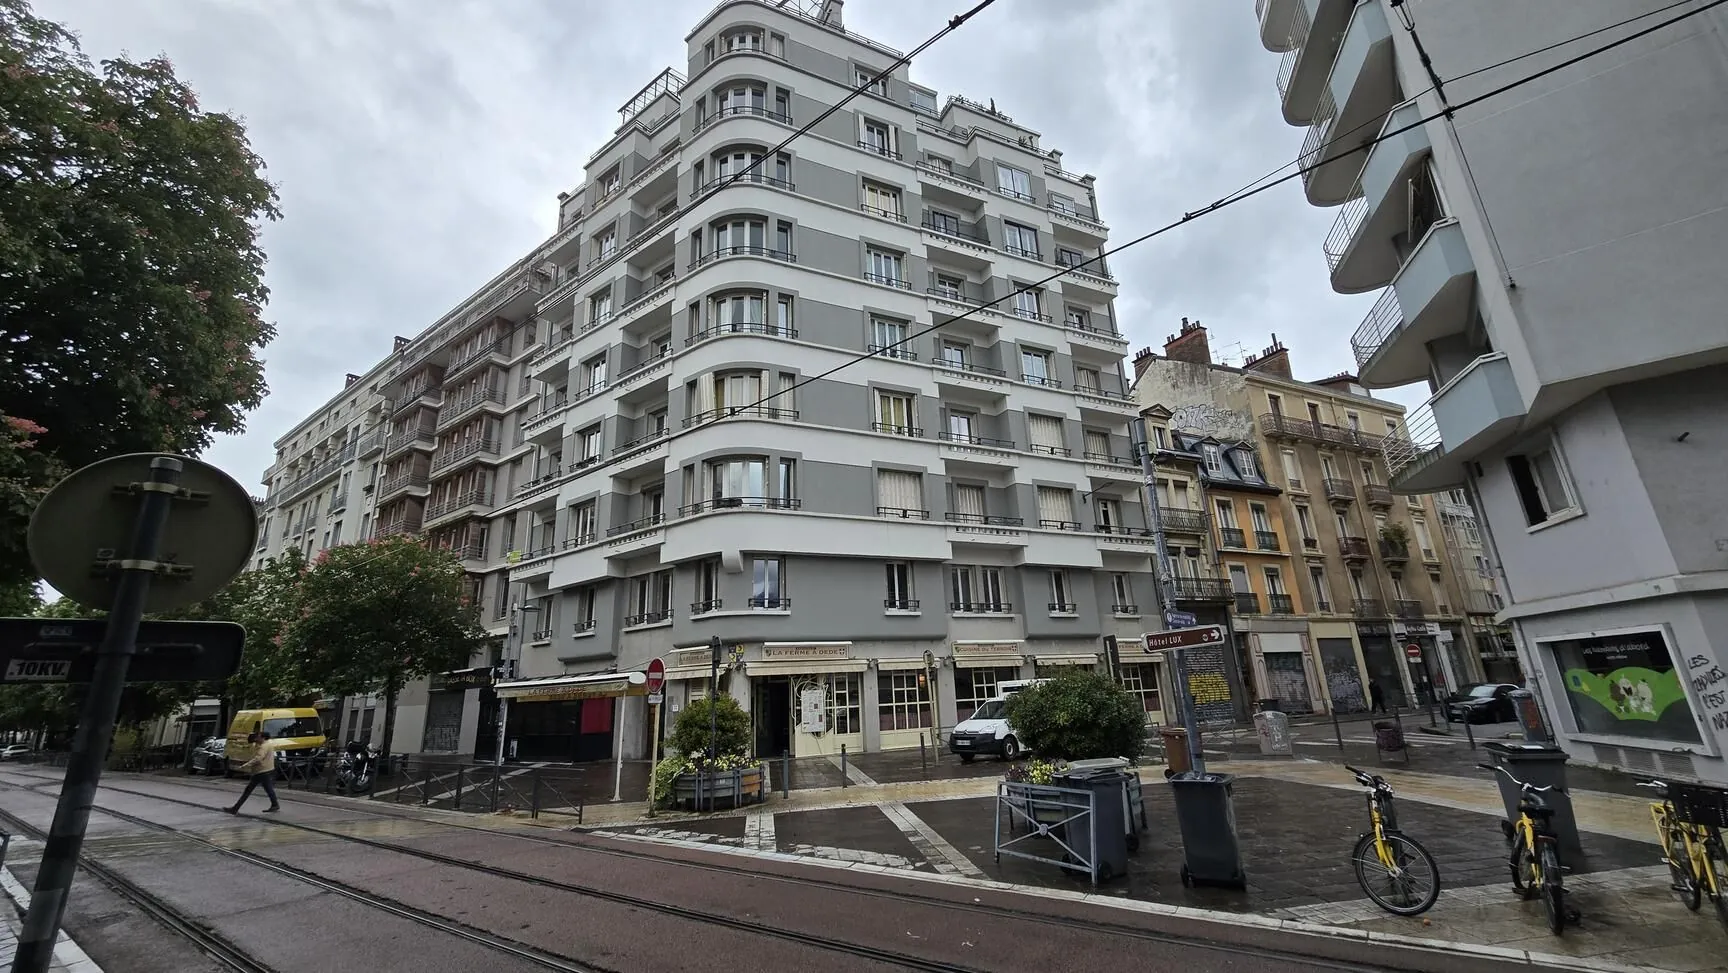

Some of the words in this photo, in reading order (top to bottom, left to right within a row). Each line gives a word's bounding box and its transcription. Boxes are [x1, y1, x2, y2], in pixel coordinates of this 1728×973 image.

[1149, 638, 1168, 647] Hôtel
[1169, 635, 1182, 644] LUX
[1688, 654, 1710, 670] LES
